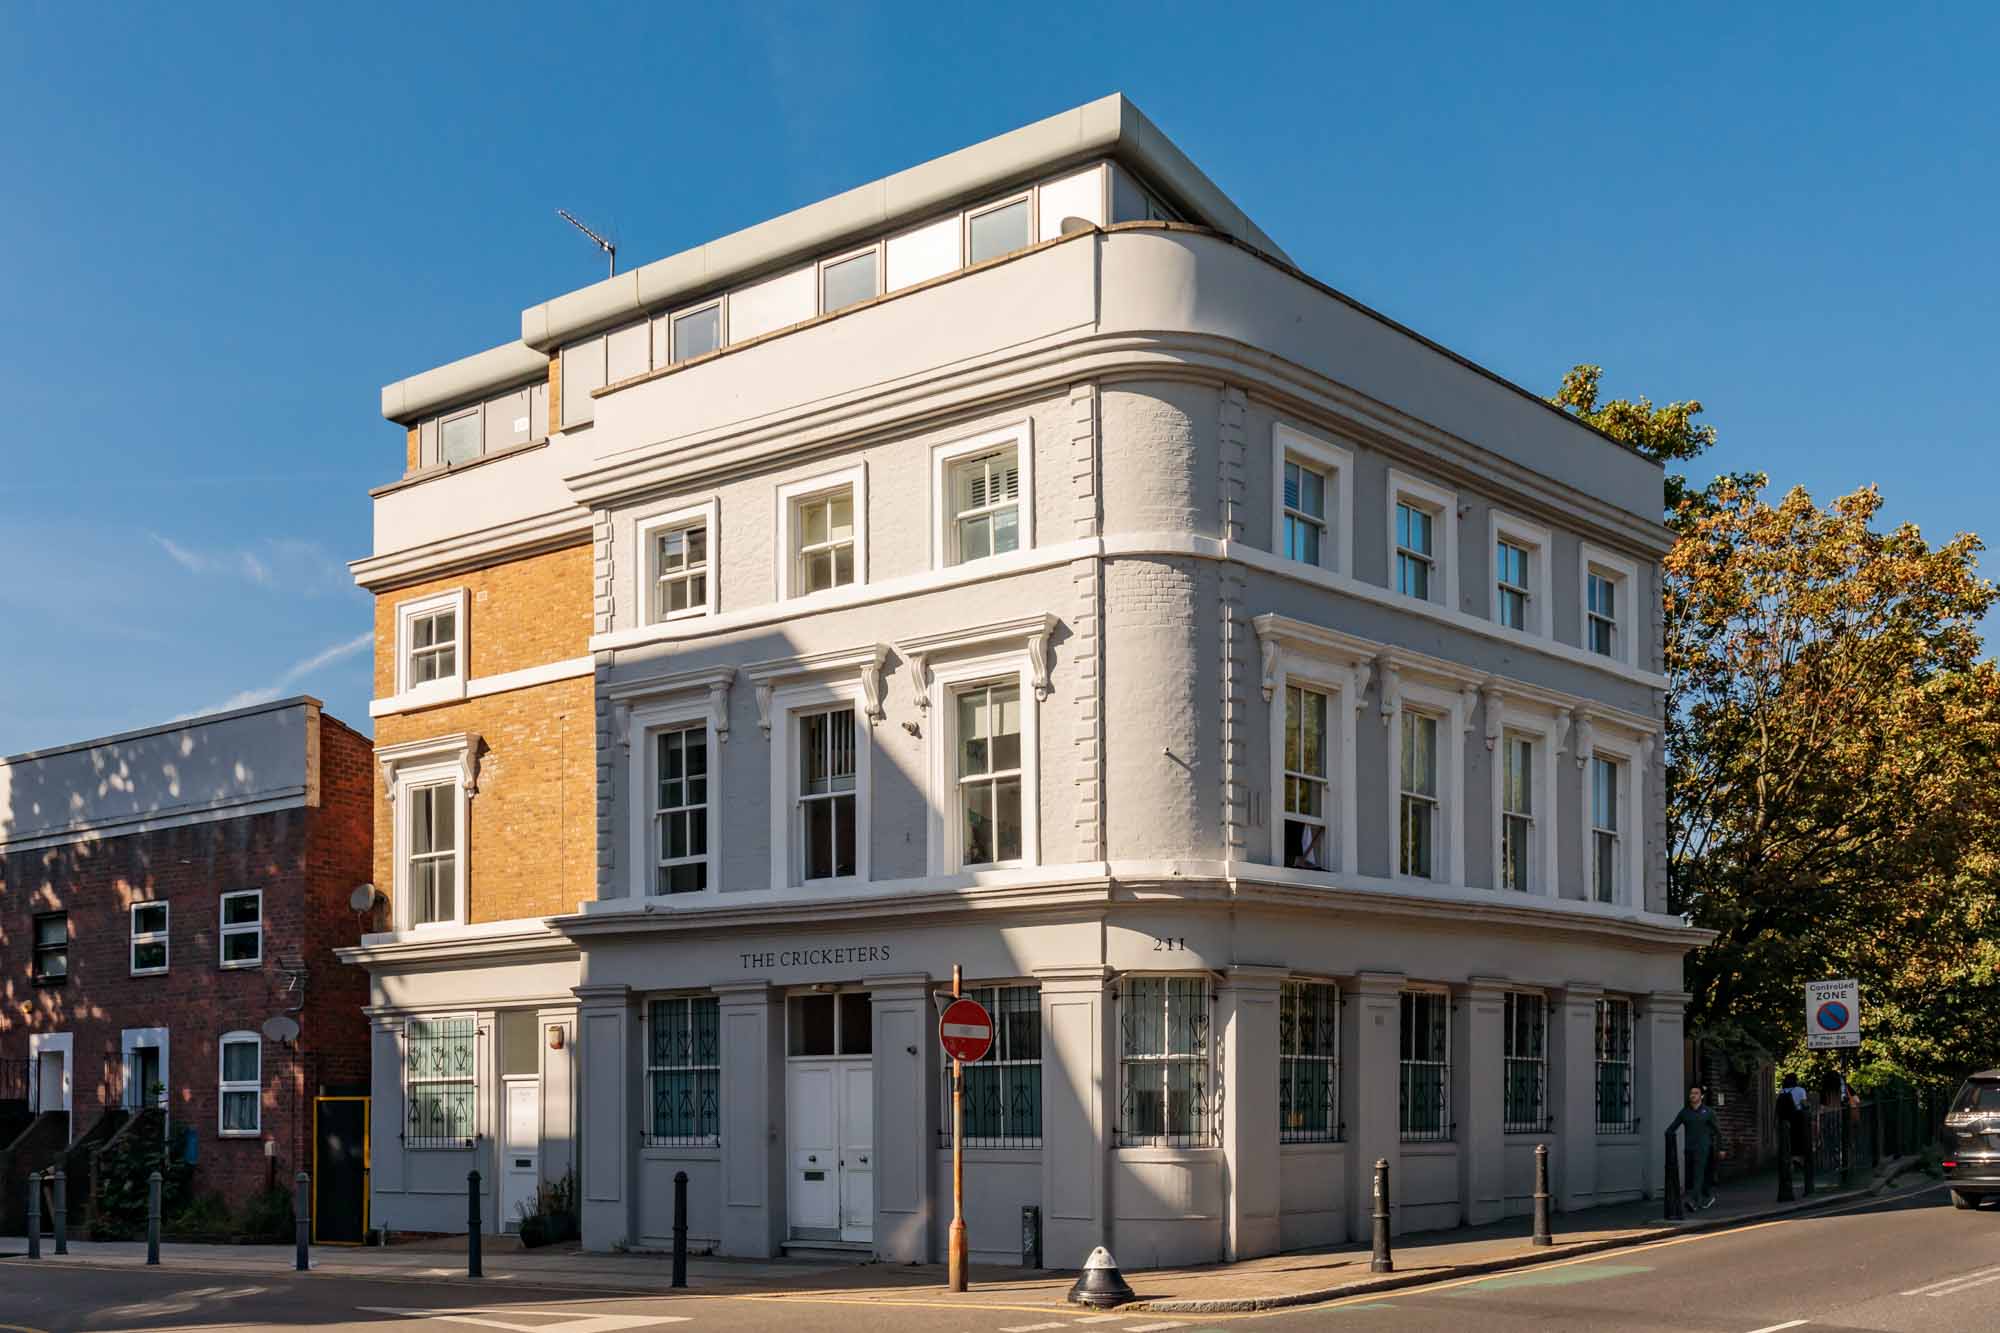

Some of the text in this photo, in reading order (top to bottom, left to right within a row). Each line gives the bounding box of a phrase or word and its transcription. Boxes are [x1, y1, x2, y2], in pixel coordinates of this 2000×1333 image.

[1153, 937, 1185, 952] 211
[740, 945, 891, 969] THE CRICKETERS
[1809, 983, 1855, 992] Controlled
[1816, 991, 1848, 1001] ZONE
